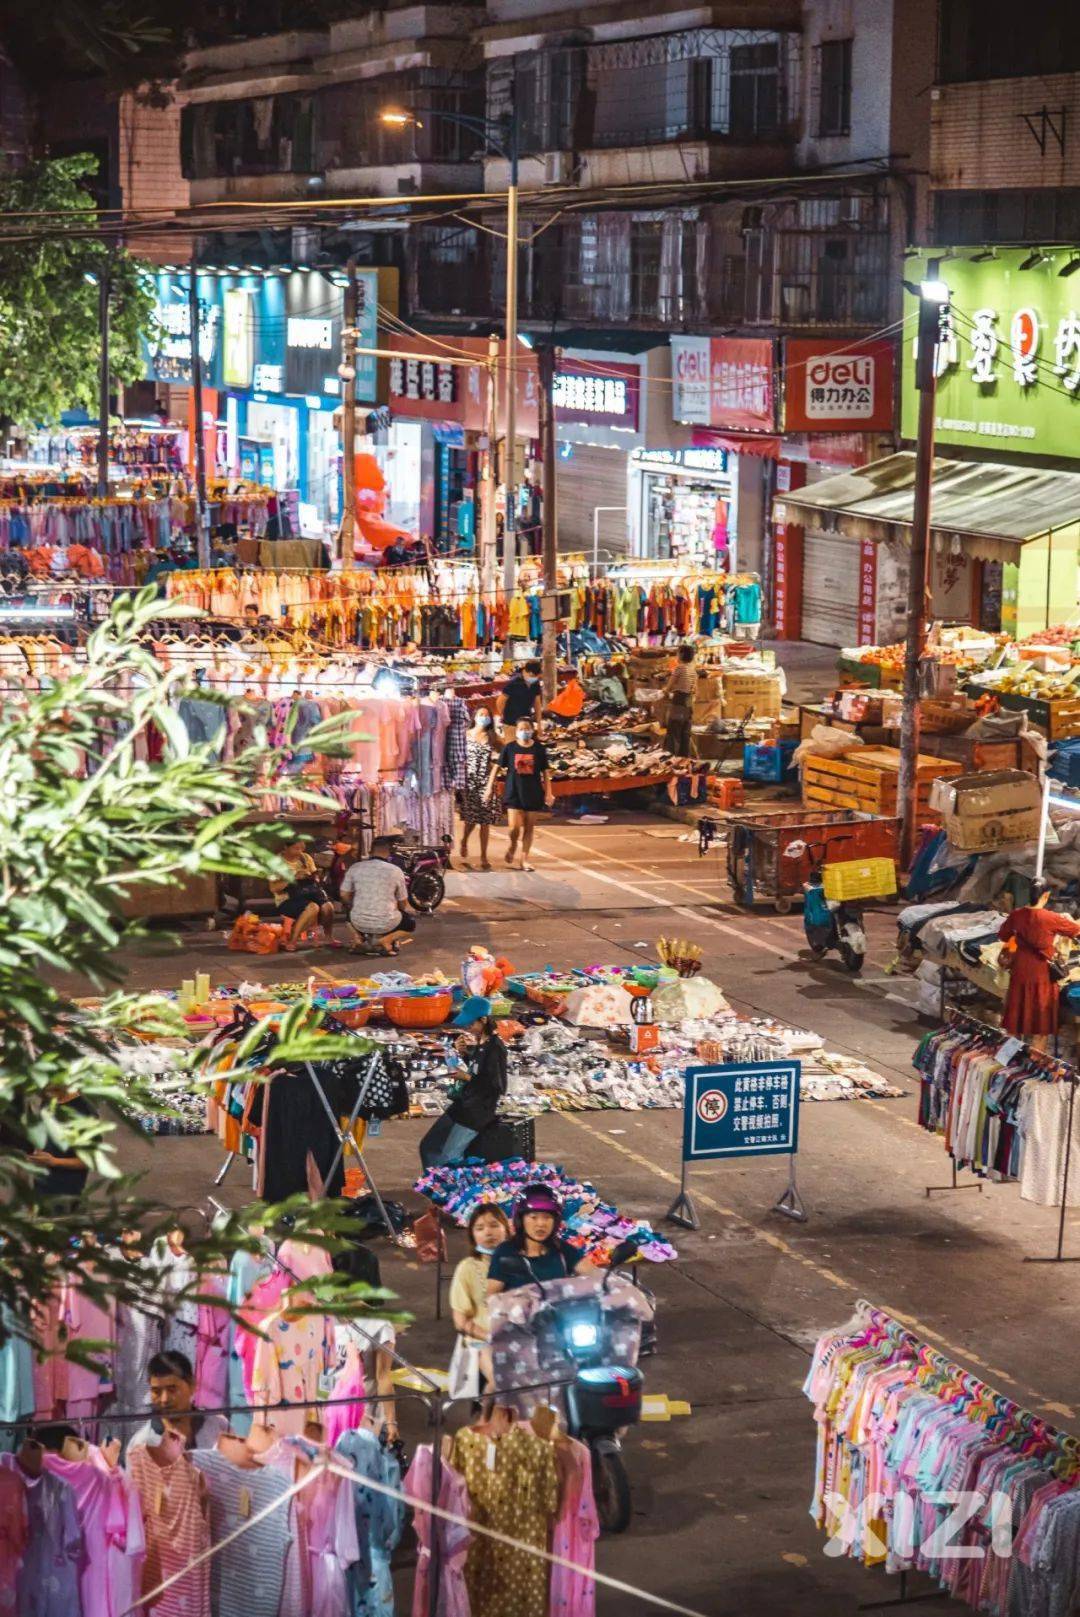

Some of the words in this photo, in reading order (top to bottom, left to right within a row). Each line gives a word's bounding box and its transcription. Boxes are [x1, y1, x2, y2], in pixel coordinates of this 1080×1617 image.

[676, 350, 707, 382] deli
[810, 361, 871, 385] deli
[810, 387, 871, 404] 得力办公
